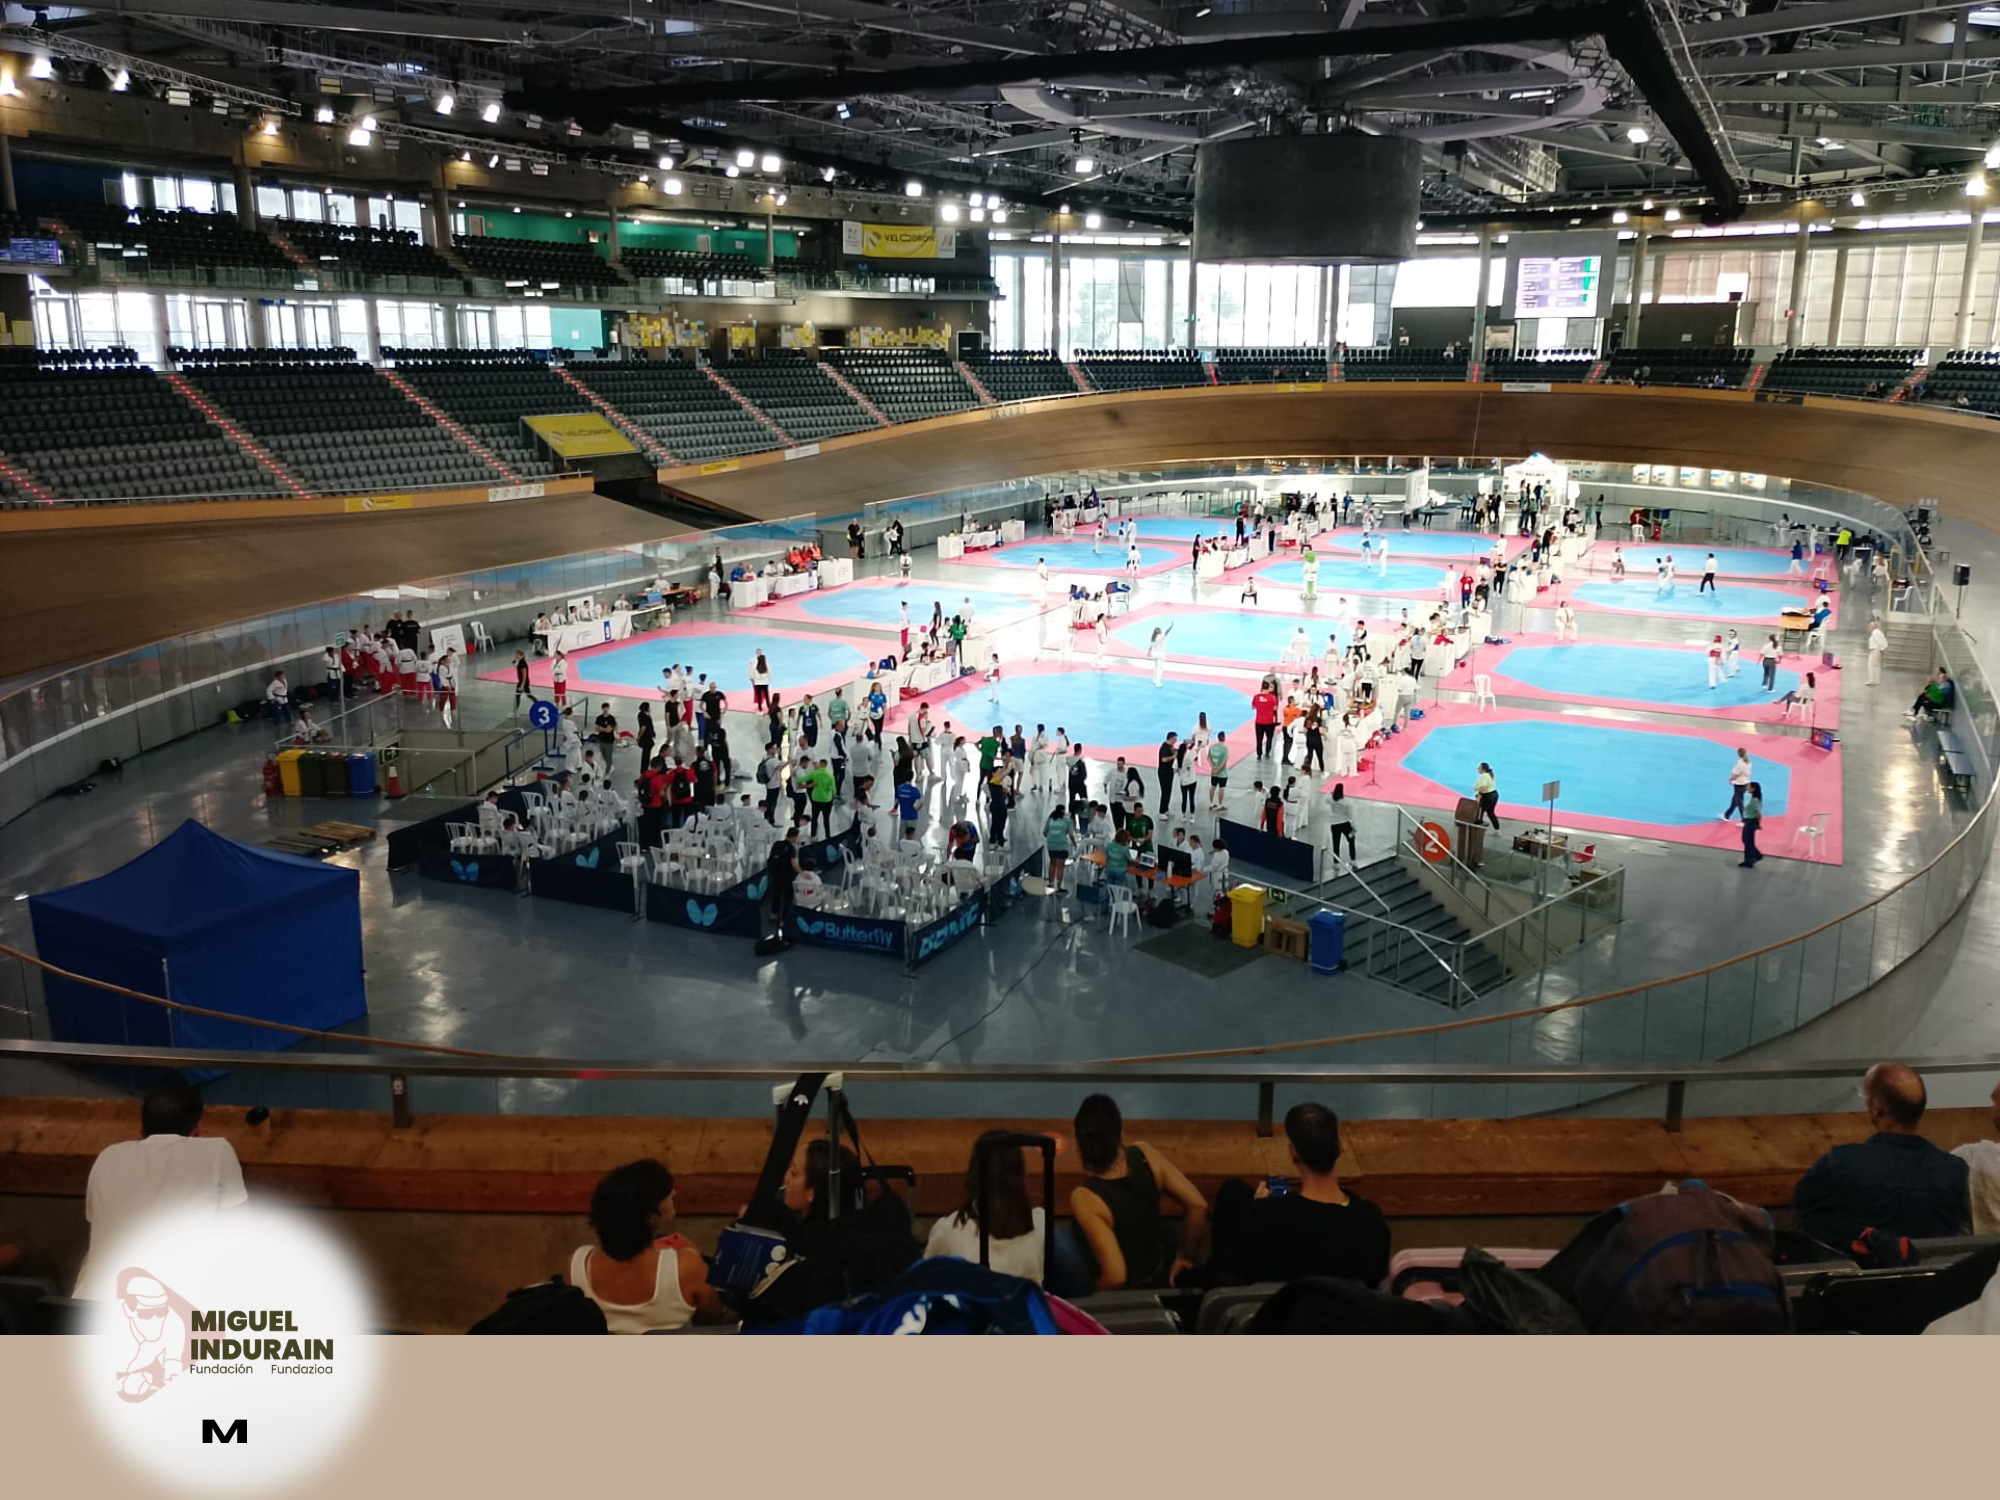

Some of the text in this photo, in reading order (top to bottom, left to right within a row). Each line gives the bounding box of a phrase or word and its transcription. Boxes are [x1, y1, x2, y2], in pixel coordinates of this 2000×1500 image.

[538, 706, 550, 725] 3
[1425, 829, 1439, 853] 2
[824, 921, 893, 948] Butterfly
